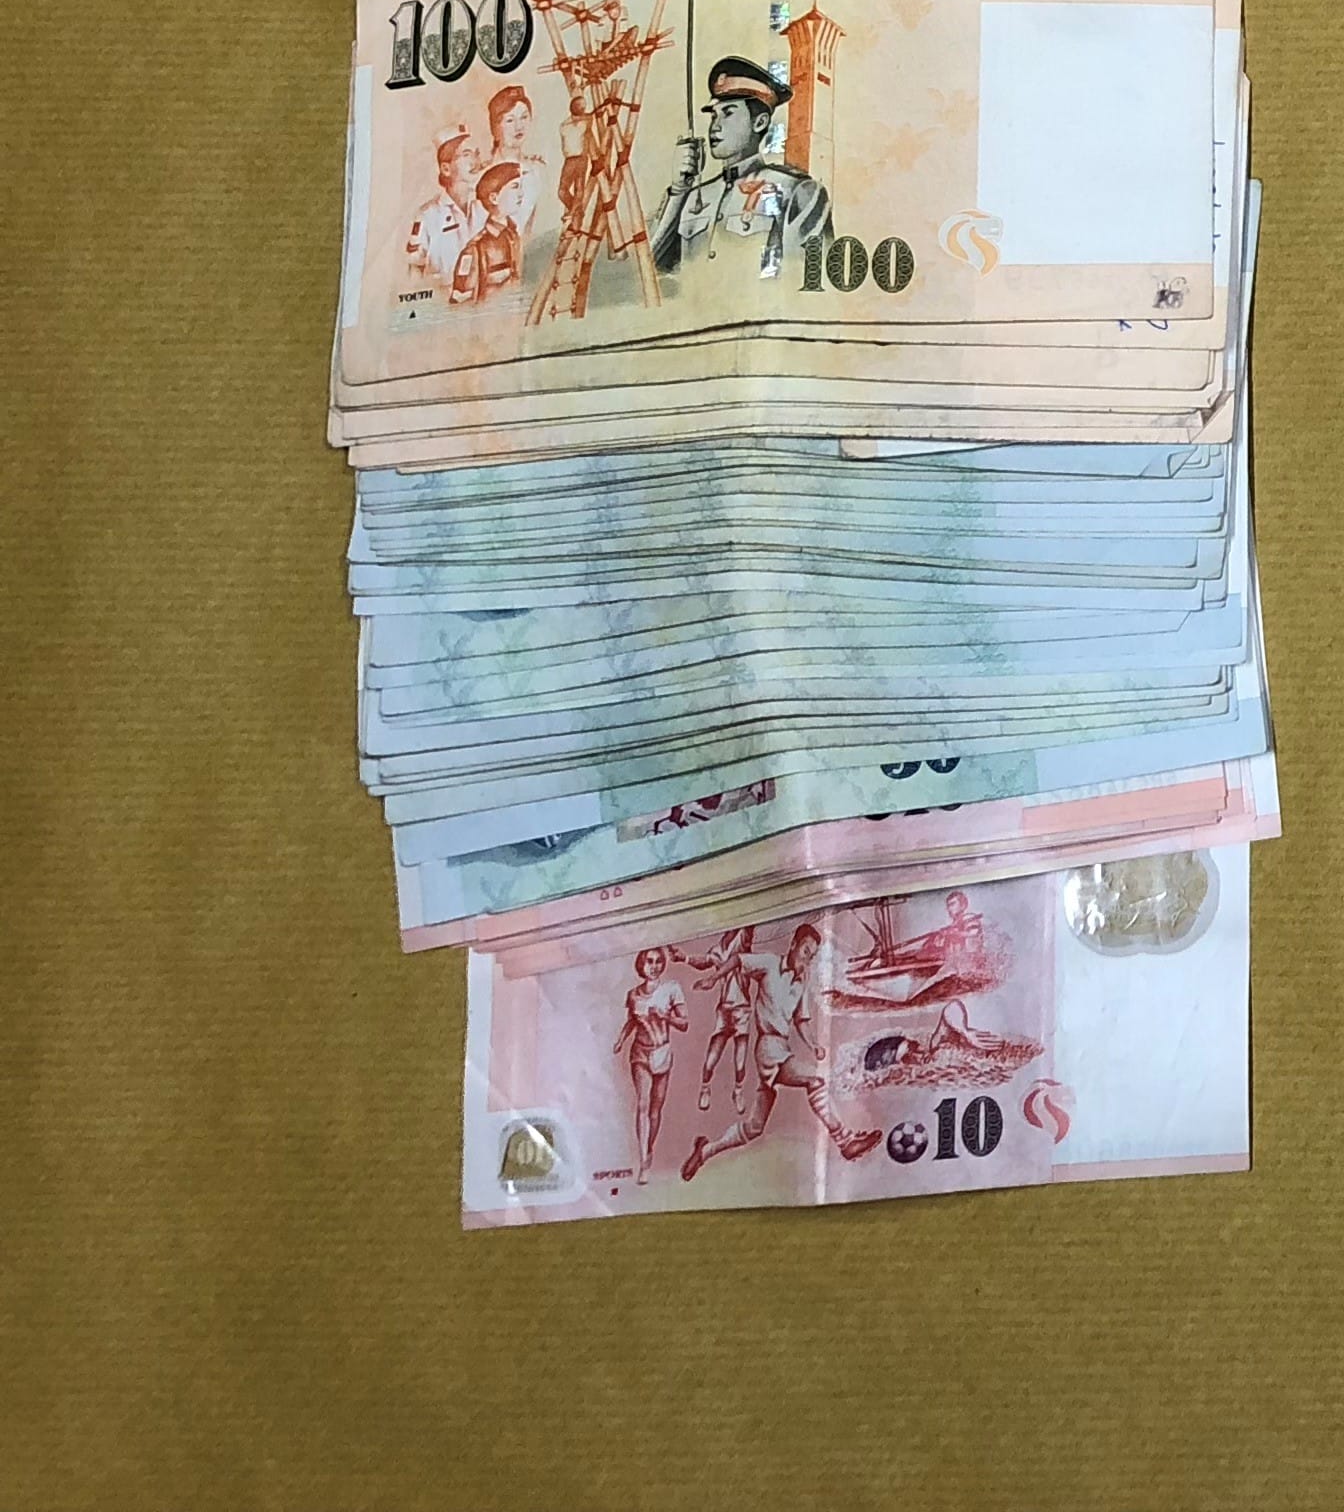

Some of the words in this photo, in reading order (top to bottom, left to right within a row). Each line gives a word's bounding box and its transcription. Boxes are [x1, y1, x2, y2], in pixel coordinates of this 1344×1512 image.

[798, 235, 915, 293] 100
[398, 289, 434, 303] YOUTH
[932, 1096, 1003, 1160] 10
